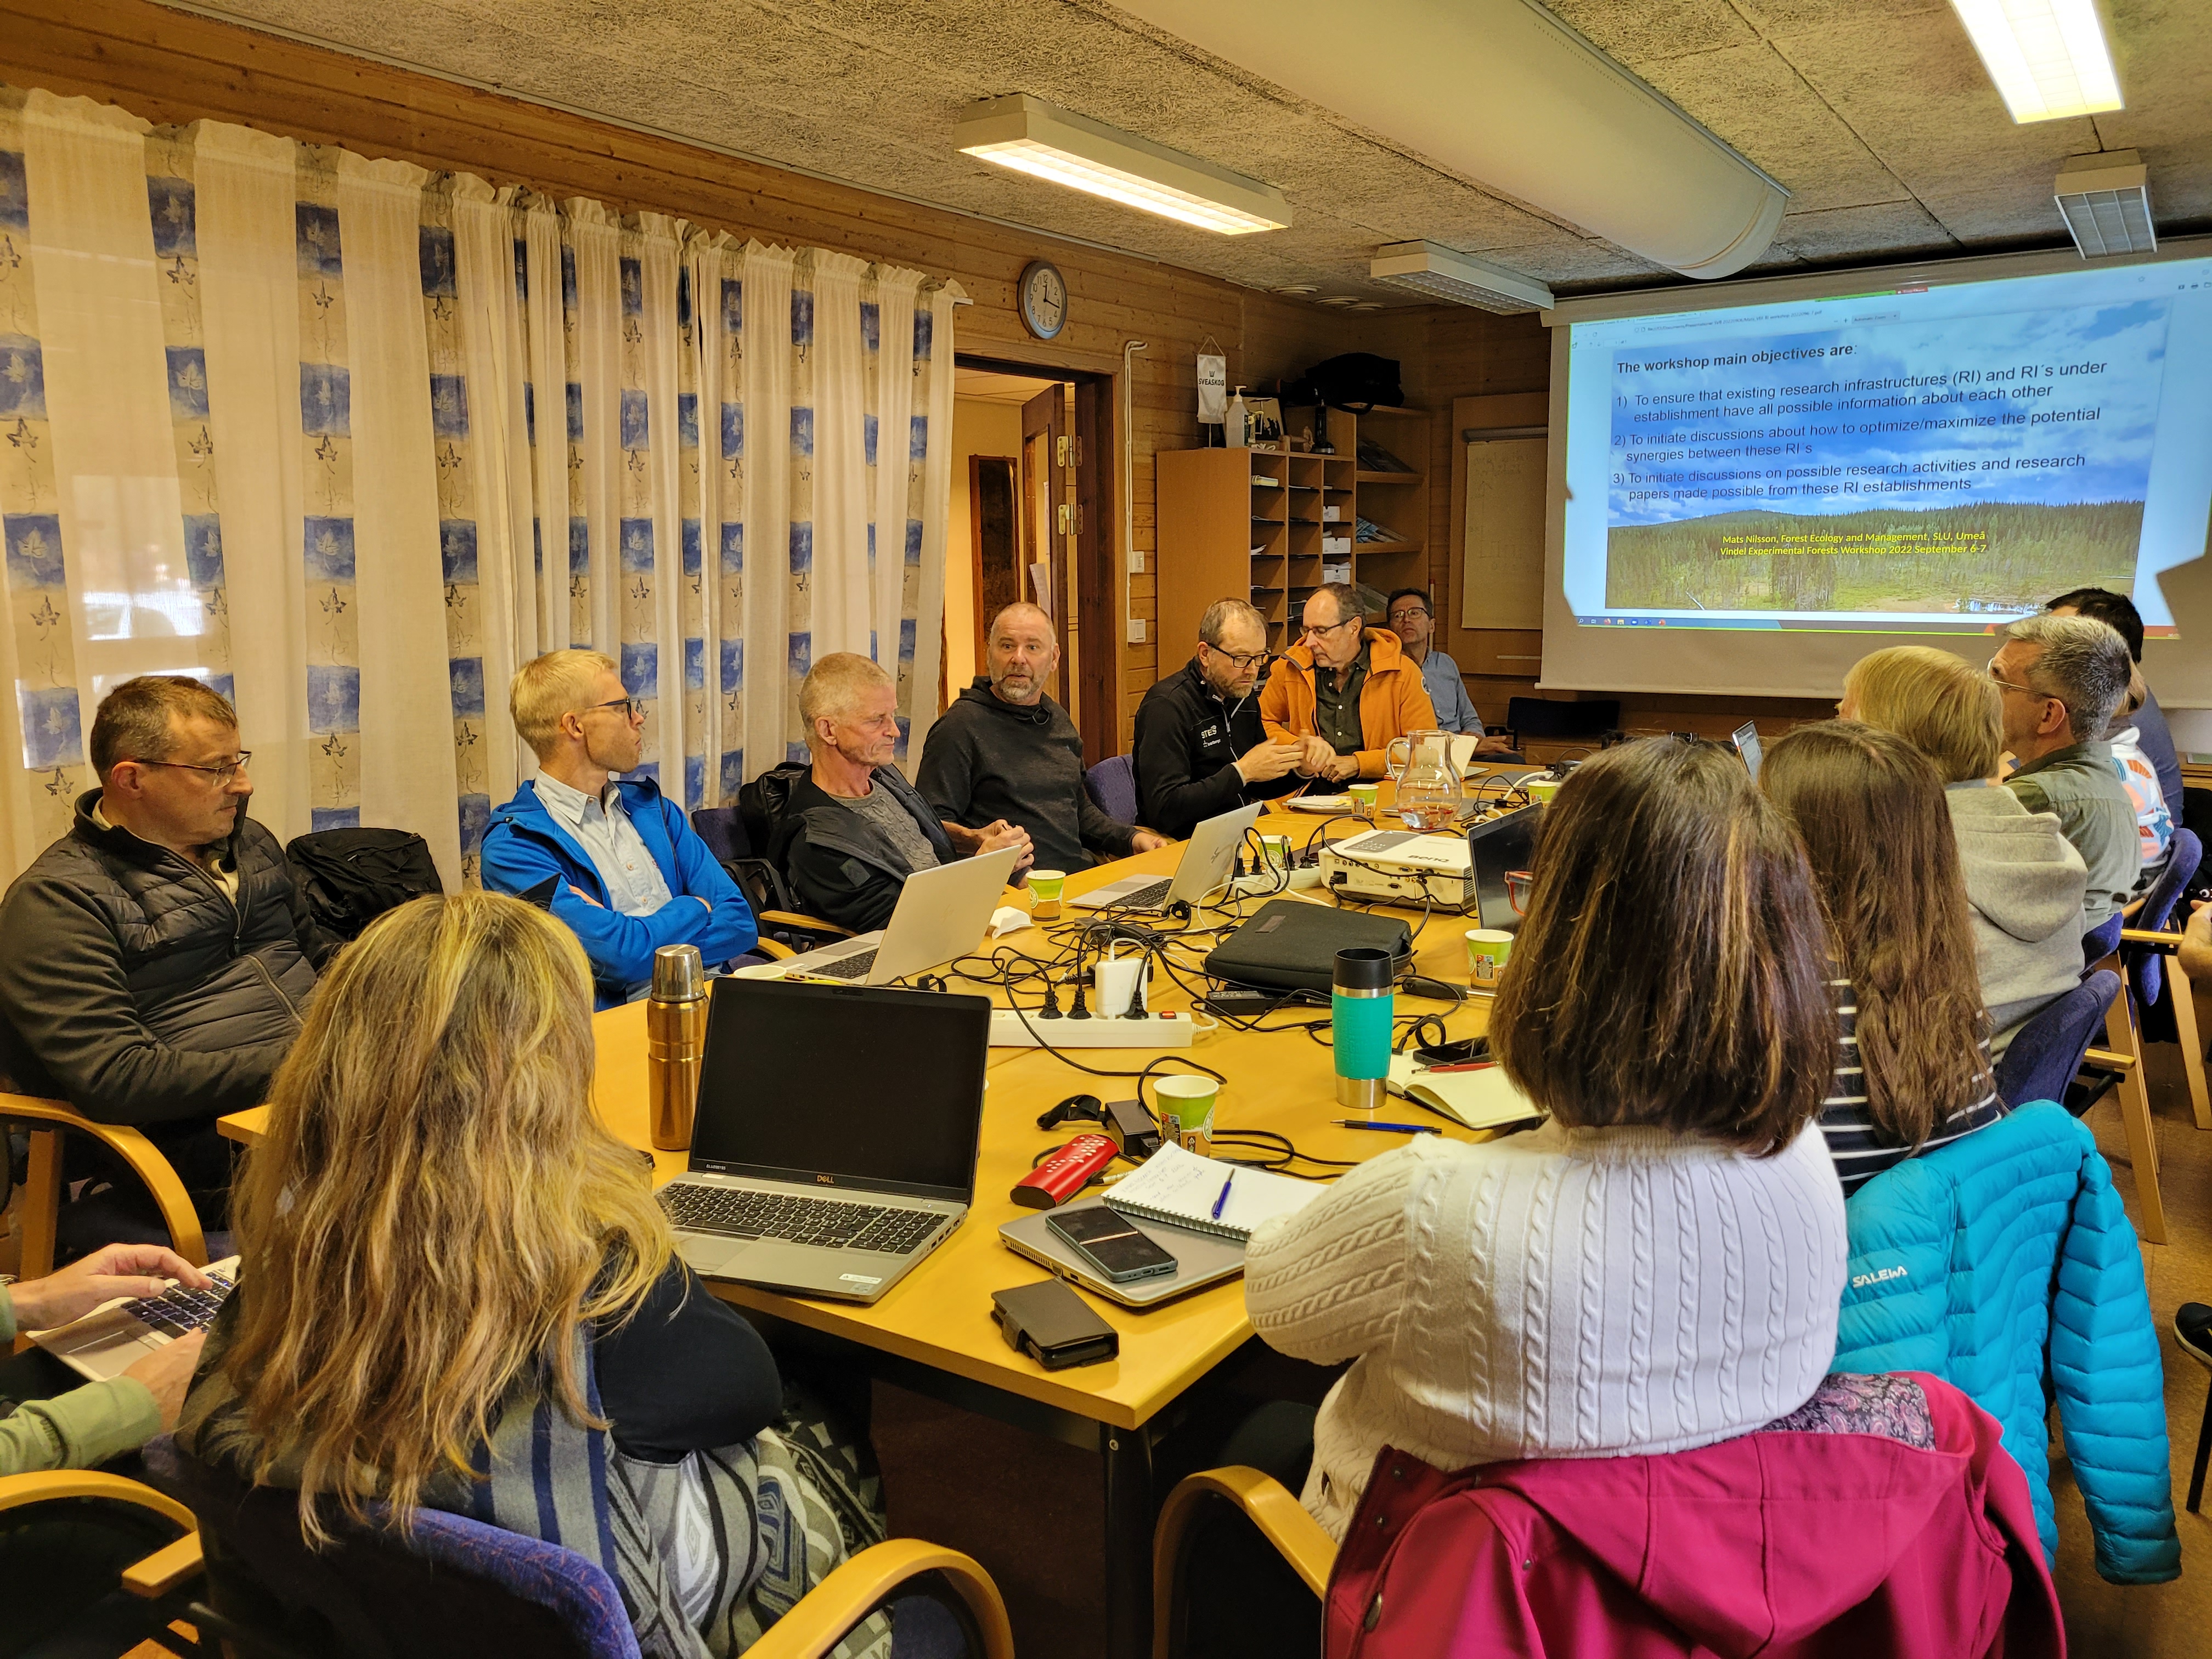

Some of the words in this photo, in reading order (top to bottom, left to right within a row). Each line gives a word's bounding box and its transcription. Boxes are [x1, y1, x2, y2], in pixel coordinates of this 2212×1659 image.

[1037, 276, 1041, 285] 11
[1043, 274, 1047, 283] 12
[1032, 283, 1037, 292] 10
[1032, 306, 1035, 314] 8
[1037, 315, 1040, 323] 7
[1042, 319, 1046, 327] 6
[1617, 362, 1640, 374] The
[1644, 357, 1709, 371] workshop
[1713, 353, 1747, 366] main
[1751, 347, 1825, 365] objectives
[1617, 396, 1627, 408] 1)
[1635, 394, 1649, 406] To
[1652, 393, 1695, 405] ensure
[1699, 389, 1723, 402] that
[1726, 386, 1775, 400] existing
[1780, 381, 1839, 397] research
[1844, 375, 1947, 392] infrastructures
[1953, 369, 1981, 387] (RI)
[1985, 366, 2016, 382] and
[2059, 361, 2108, 376] under
[1634, 407, 1719, 422] establishment
[1723, 405, 1754, 417] have
[1758, 403, 1773, 415] all
[1778, 399, 1833, 417] possible
[1838, 394, 1916, 410] information
[1921, 390, 1964, 405] about
[1968, 387, 2006, 402] each
[2011, 385, 2053, 398] other
[1614, 435, 1626, 448] 2)
[1629, 435, 1643, 445] To
[1647, 432, 1686, 445] initiate
[1690, 430, 1764, 442] discussions
[1768, 425, 1805, 438] about
[1810, 424, 1838, 436] how
[1843, 423, 1855, 434] to
[1859, 416, 1996, 435] optimize/maximize
[2002, 412, 2026, 425] the
[2030, 407, 2101, 427] potential
[1626, 450, 1684, 464] synergies
[1688, 447, 1741, 459] between
[1746, 444, 1781, 456] these
[1613, 473, 1624, 487] 3)
[1628, 472, 1642, 483] To
[1645, 471, 1684, 483] initiate
[1688, 470, 1762, 482] discussions
[1765, 470, 1782, 479] on
[1785, 465, 1842, 481] possible
[1846, 462, 1908, 476] research
[1912, 459, 1977, 473] activities
[1981, 456, 2011, 470] and
[2015, 454, 2085, 469] research
[1629, 489, 1670, 501] papers
[1673, 487, 1708, 499] made
[1712, 484, 1764, 500] possible
[1768, 484, 1798, 496] from
[1801, 483, 1839, 495] these
[1843, 481, 1859, 494] RI
[1863, 478, 1972, 493] establishments
[1746, 535, 1779, 544] Nilsson,
[1781, 534, 1808, 543] Forest
[1810, 534, 1843, 543] Ecology
[1846, 534, 1863, 542] and
[1933, 532, 1954, 541] SLU,
[1957, 531, 1985, 540] Umeå
[1720, 547, 1747, 555] Vindel
[1748, 546, 1805, 556] Experimental
[1807, 544, 1838, 556] Forests
[1841, 545, 1887, 555] Workshop
[1889, 545, 1912, 554] 2022
[1915, 545, 1967, 554] September
[1970, 544, 1987, 553] 6-7
[1408, 855, 1449, 863] BenQ
[817, 1175, 834, 1183] DELL
[1852, 1266, 1908, 1289] SALEWA
